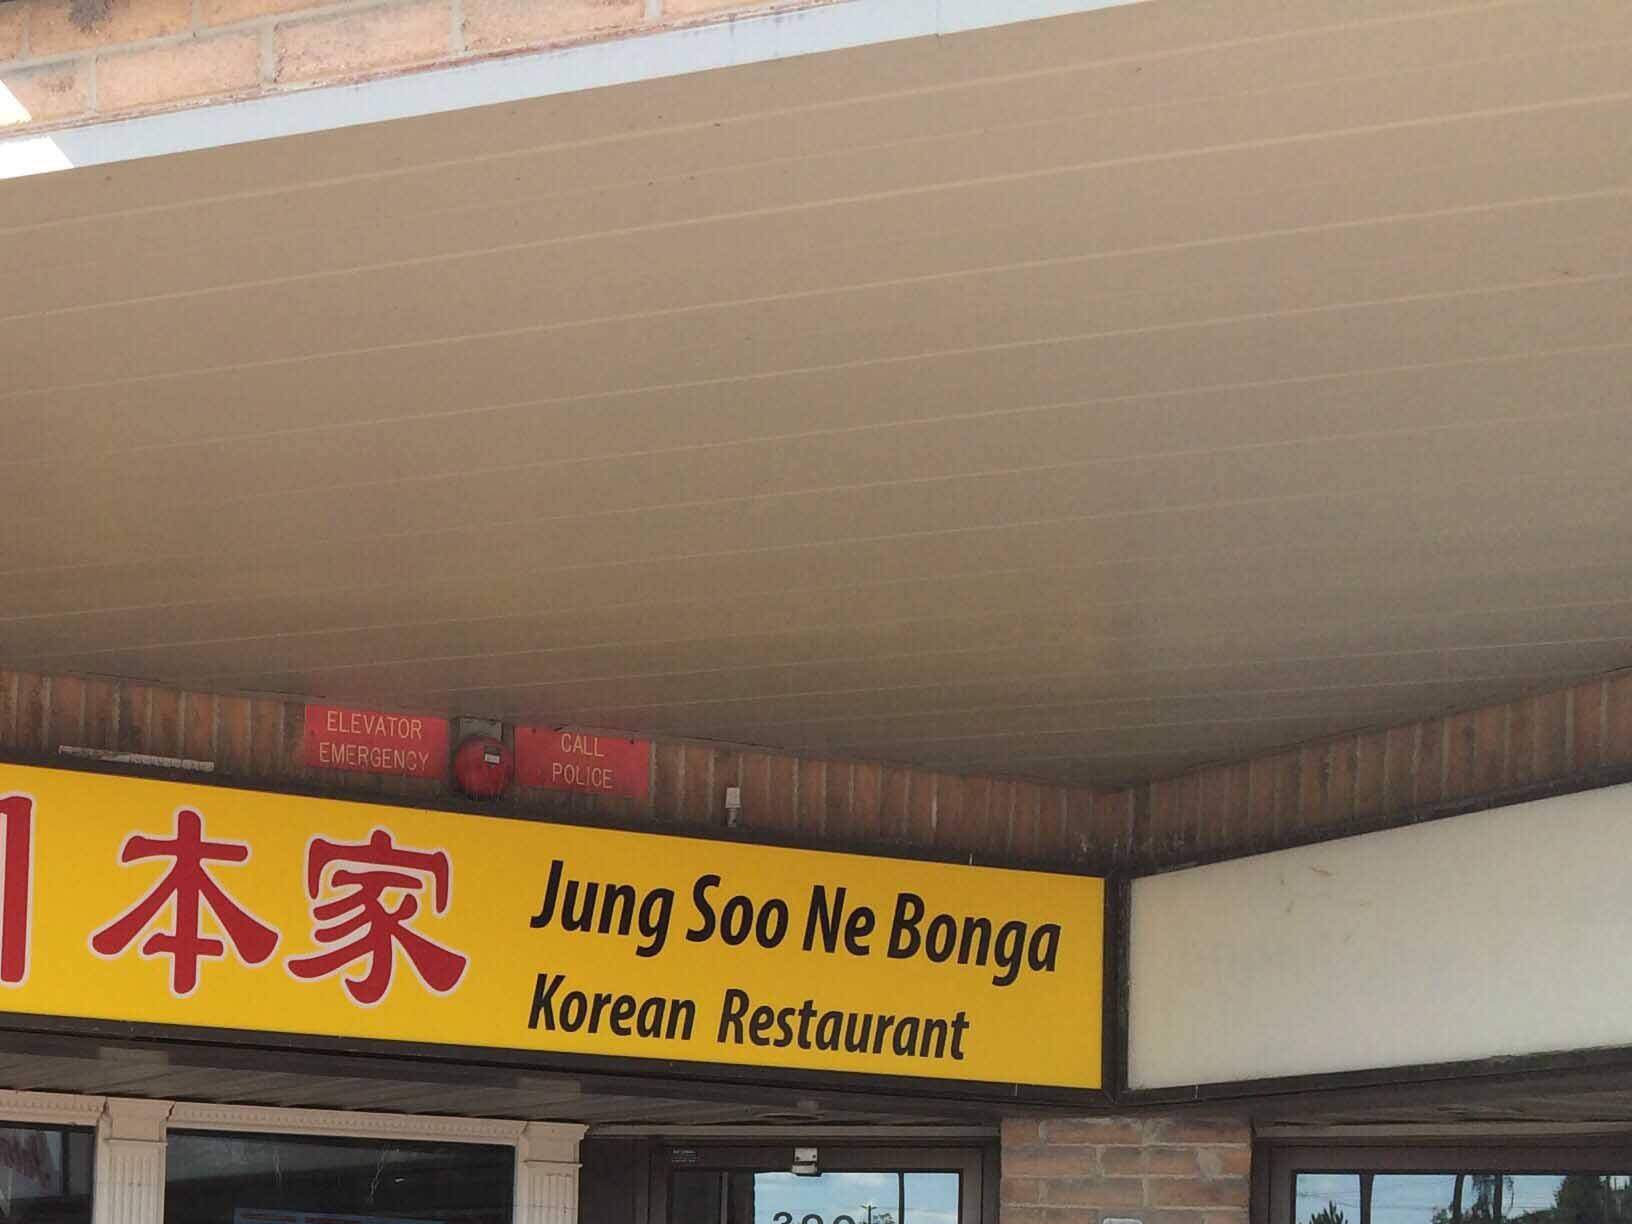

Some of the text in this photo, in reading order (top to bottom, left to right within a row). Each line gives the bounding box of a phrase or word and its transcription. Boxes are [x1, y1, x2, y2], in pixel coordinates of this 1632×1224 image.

[326, 710, 424, 741] ELEVATOR
[318, 741, 430, 773] EMERGENCY
[561, 732, 605, 758] CALL
[552, 761, 614, 790] POLICE
[529, 859, 1062, 987] Jung Soo Ne Bonga
[528, 972, 971, 1060] Korean Restaurant
